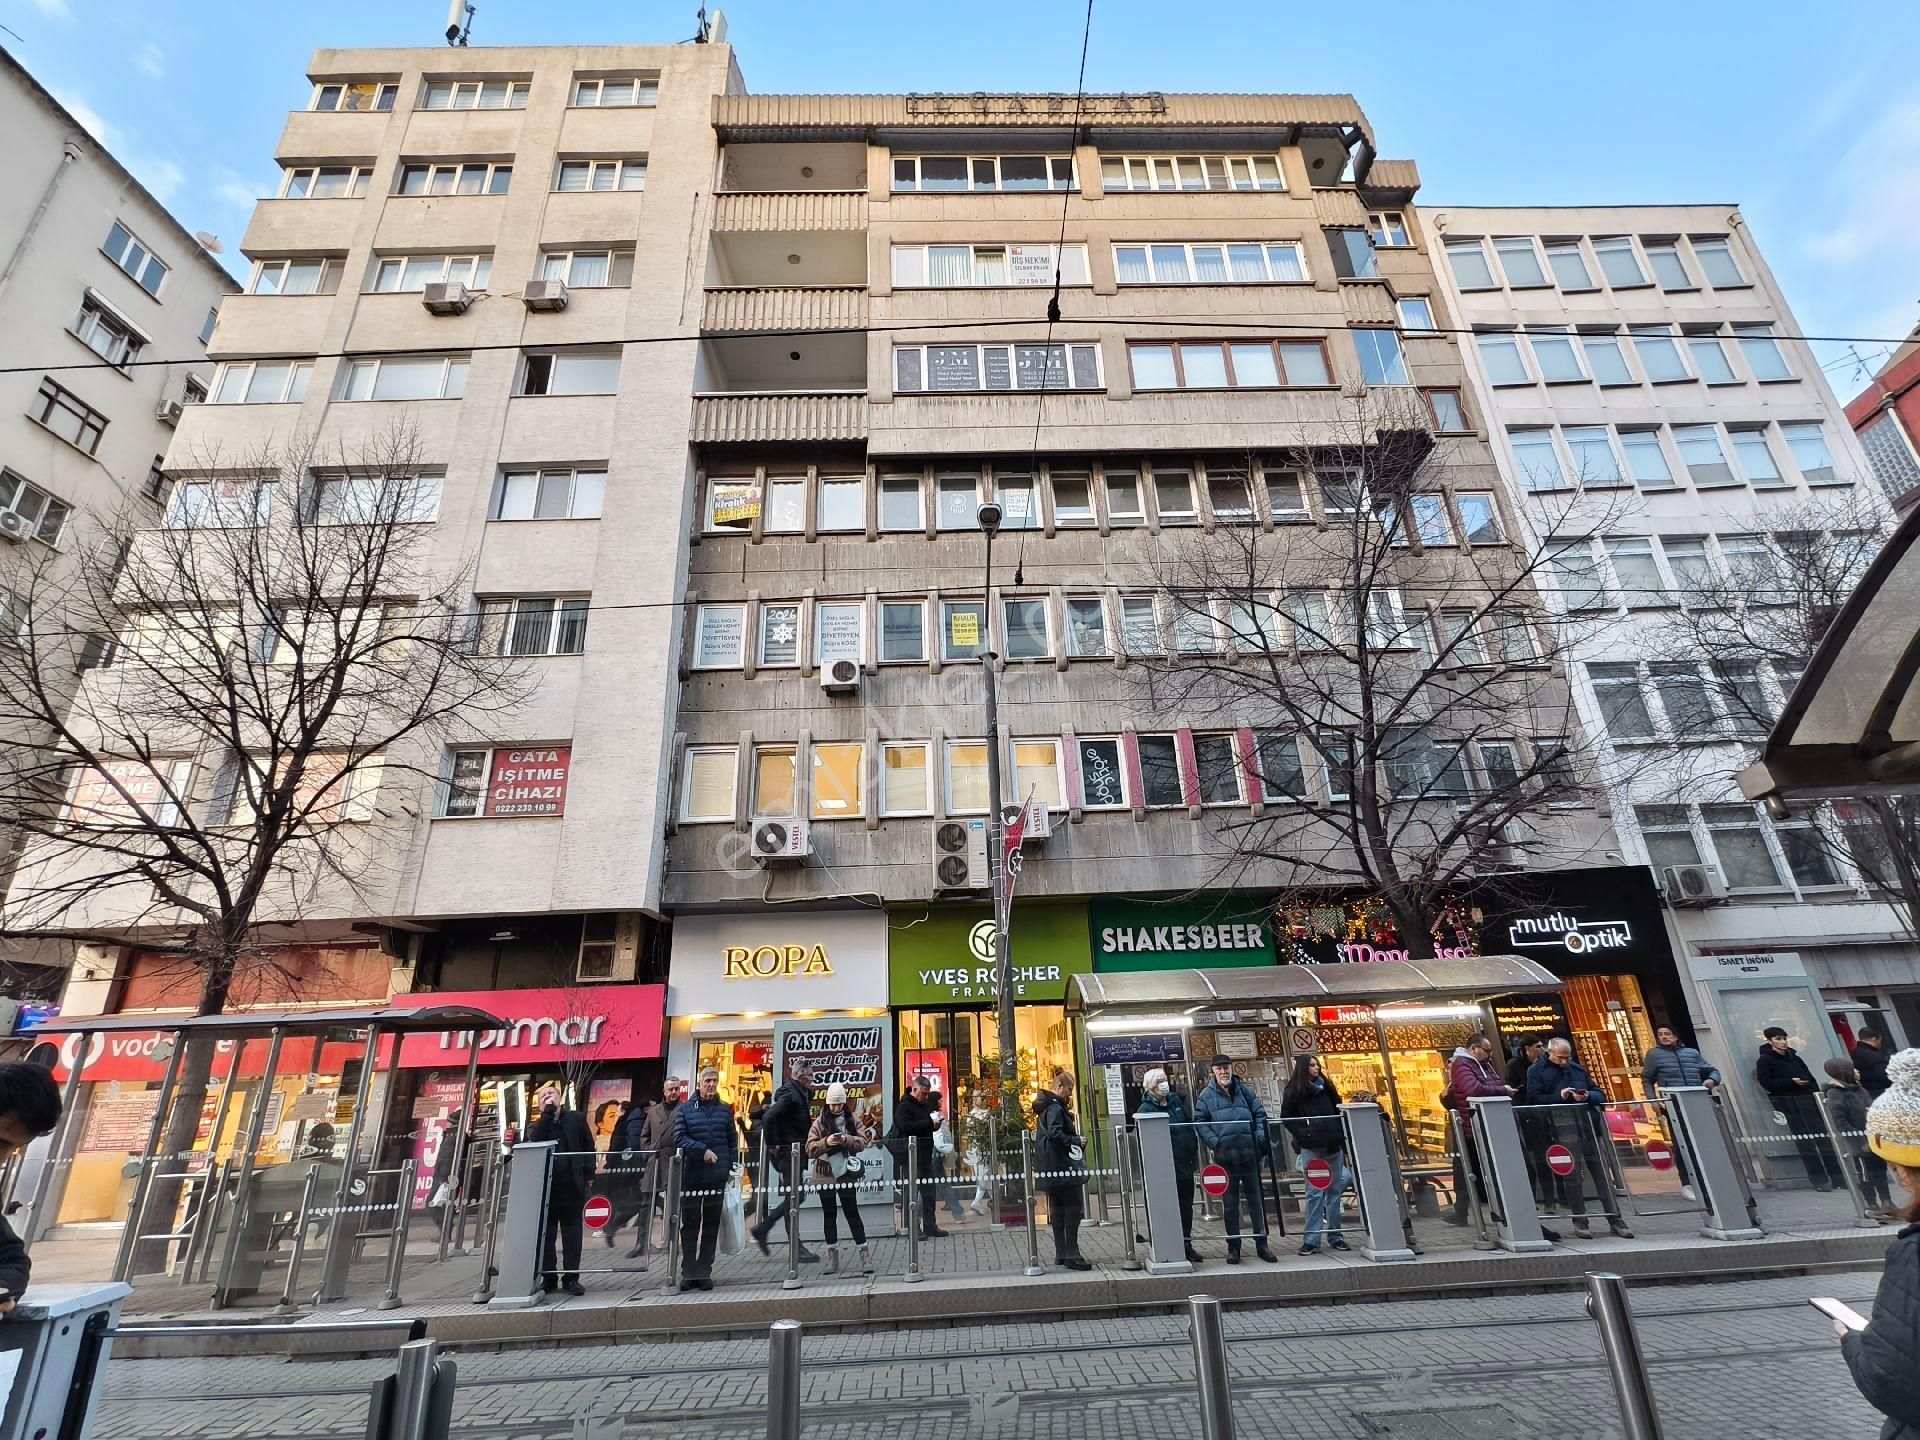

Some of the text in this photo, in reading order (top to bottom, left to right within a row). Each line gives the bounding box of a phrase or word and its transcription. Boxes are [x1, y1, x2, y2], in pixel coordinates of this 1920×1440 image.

[768, 609, 796, 620] 2026
[463, 760, 479, 769] PİL
[509, 750, 559, 763] GATA
[498, 767, 565, 784] İŞİTME
[495, 785, 562, 800] CİHAZI
[1088, 771, 1115, 804] shop
[496, 804, 516, 812] 0222
[517, 804, 532, 812] 230
[546, 803, 556, 811] 99
[1033, 807, 1041, 832] VESTEL
[1516, 912, 1577, 933] mutlu
[1102, 924, 1264, 952] SHAKESBEER
[1564, 928, 1626, 953] Optik
[724, 944, 833, 977] ROPA
[1718, 955, 1774, 965] İSMET İNÖNÜ
[919, 969, 969, 985] YVES
[952, 985, 1024, 997] FRANE
[787, 1028, 878, 1052] GASTRONOMİ
[834, 1053, 878, 1065] Ürünler
[813, 1066, 876, 1085] stivali
